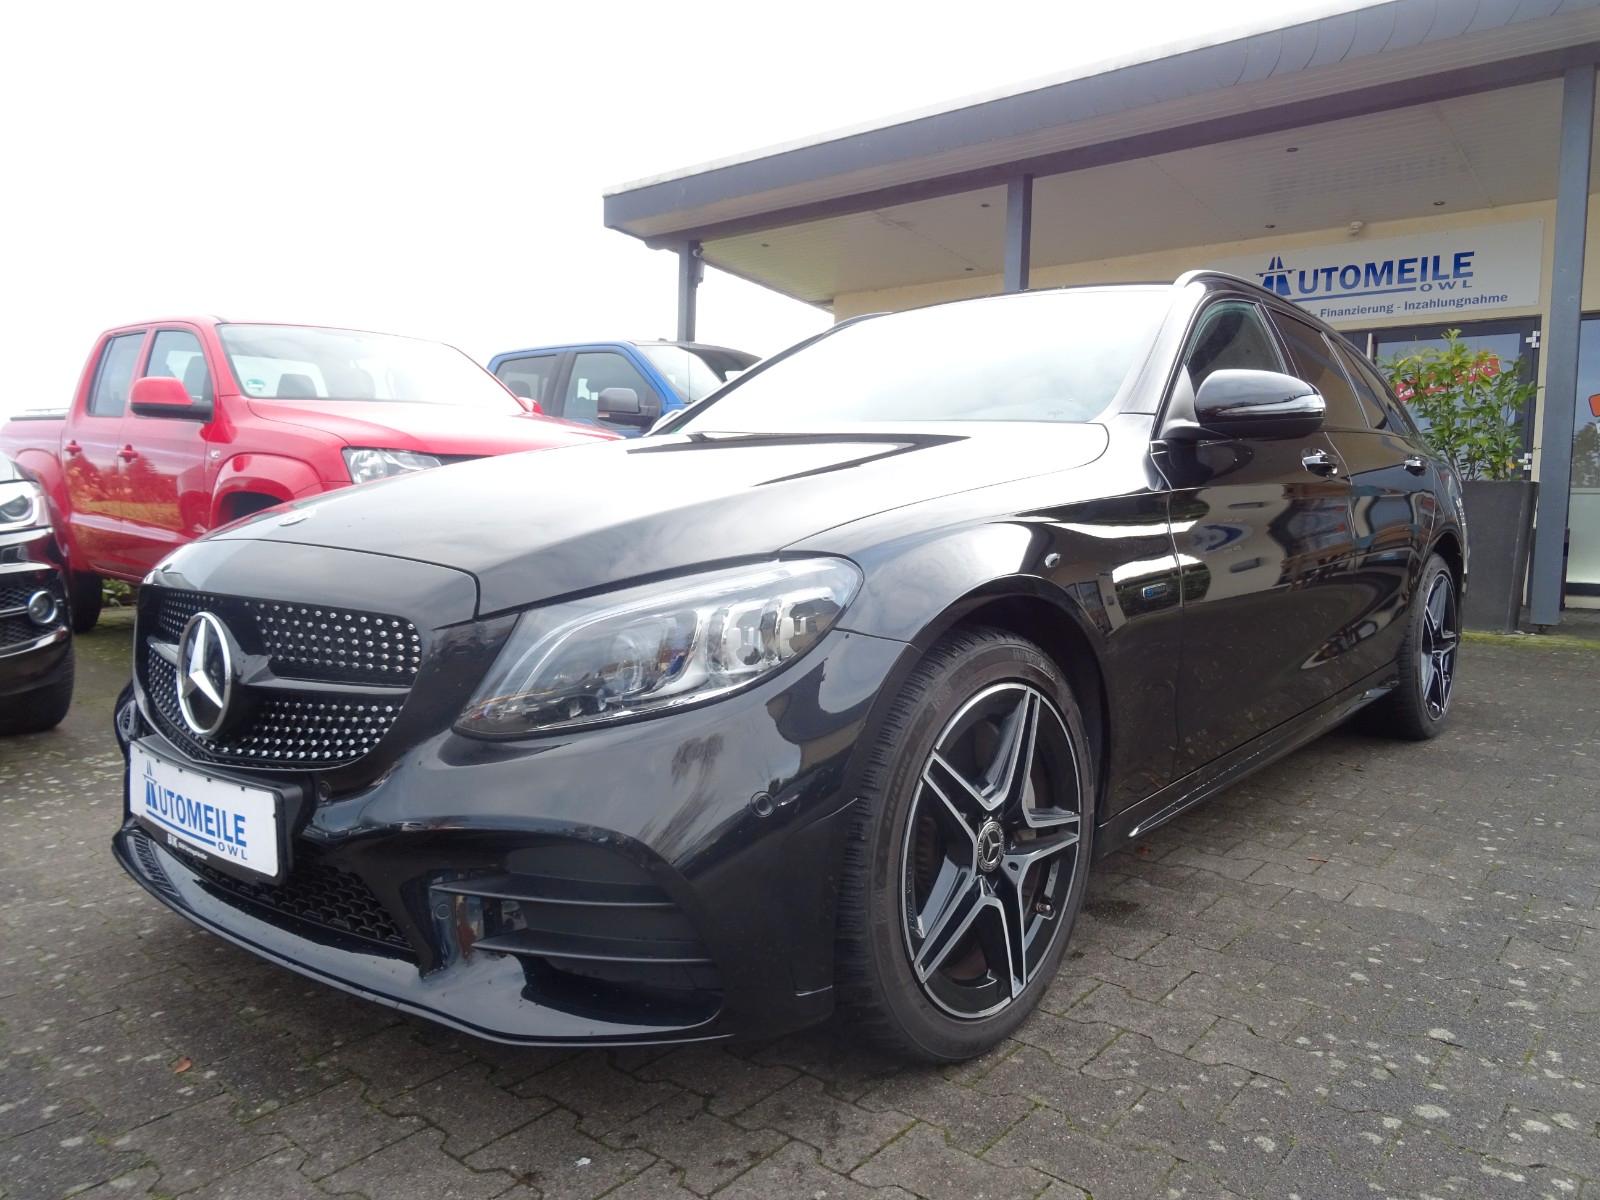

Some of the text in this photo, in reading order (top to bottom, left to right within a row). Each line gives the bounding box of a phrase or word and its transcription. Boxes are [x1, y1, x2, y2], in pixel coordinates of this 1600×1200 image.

[1256, 251, 1475, 296] AUTOMEILE
[1420, 280, 1473, 292] OWL
[1320, 303, 1394, 318] Finanzierung
[1404, 294, 1508, 310] Inzahlungnahme
[143, 760, 247, 847] AUTOMEILE
[218, 842, 248, 860] OWL
